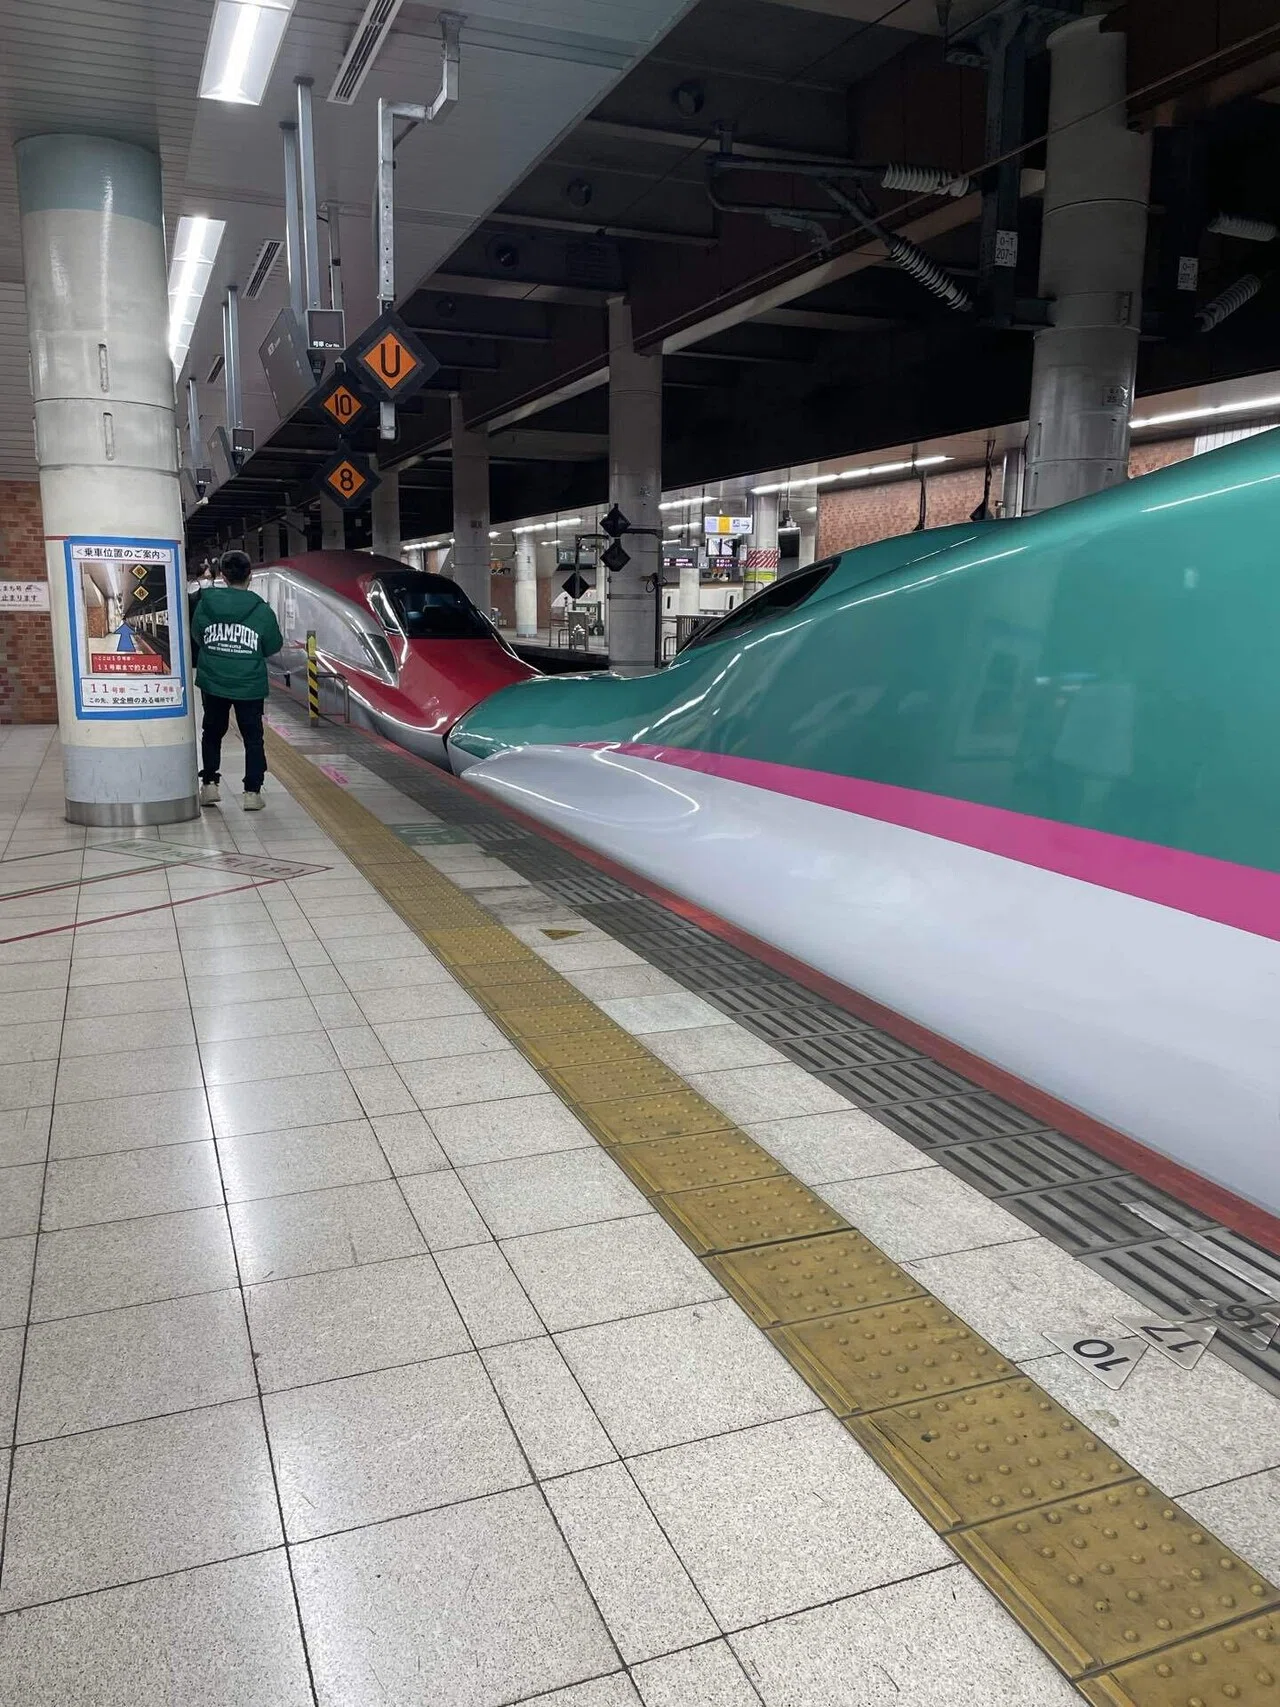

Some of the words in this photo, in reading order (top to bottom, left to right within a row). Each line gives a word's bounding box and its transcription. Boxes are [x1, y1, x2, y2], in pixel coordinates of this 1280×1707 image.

[380, 343, 400, 378] U
[334, 393, 352, 416] 10
[340, 467, 354, 491] 8
[203, 622, 259, 652] CHAMPION
[1215, 1304, 1273, 1333] 16
[1140, 1326, 1203, 1353] 17
[1073, 1339, 1130, 1372] 10
